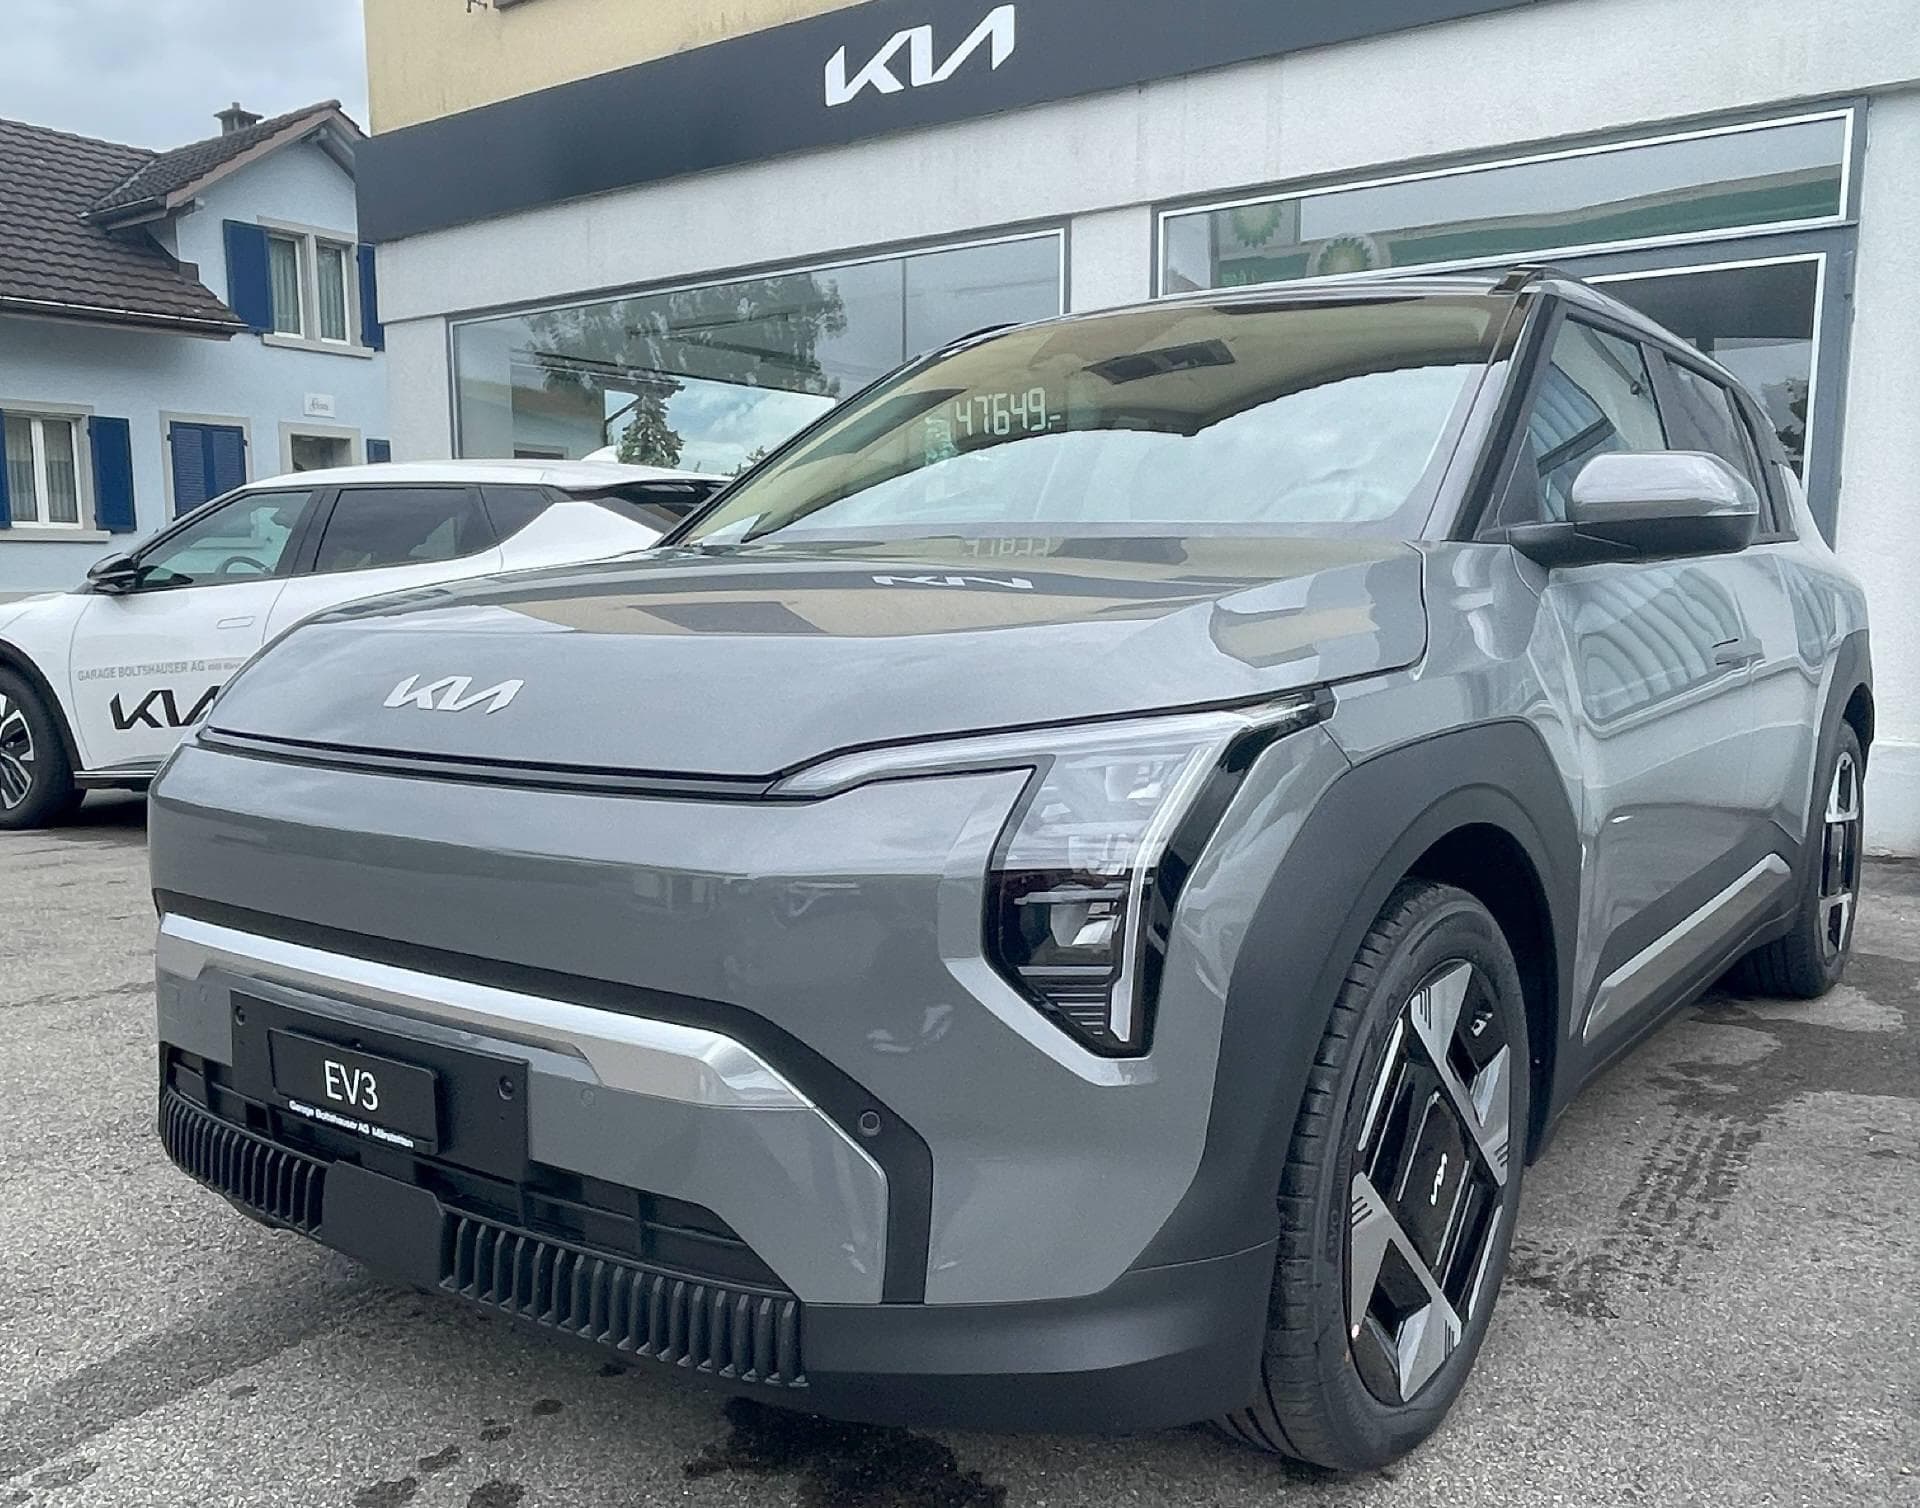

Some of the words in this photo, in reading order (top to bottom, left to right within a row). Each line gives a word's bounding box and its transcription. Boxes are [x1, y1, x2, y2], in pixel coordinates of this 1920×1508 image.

[825, 4, 1015, 107] KIA
[78, 667, 116, 681] GARAGE
[118, 661, 188, 678] BOLTSHAUSER
[190, 660, 205, 672] AG
[383, 673, 525, 715] KIA
[324, 1060, 379, 1111] EV3
